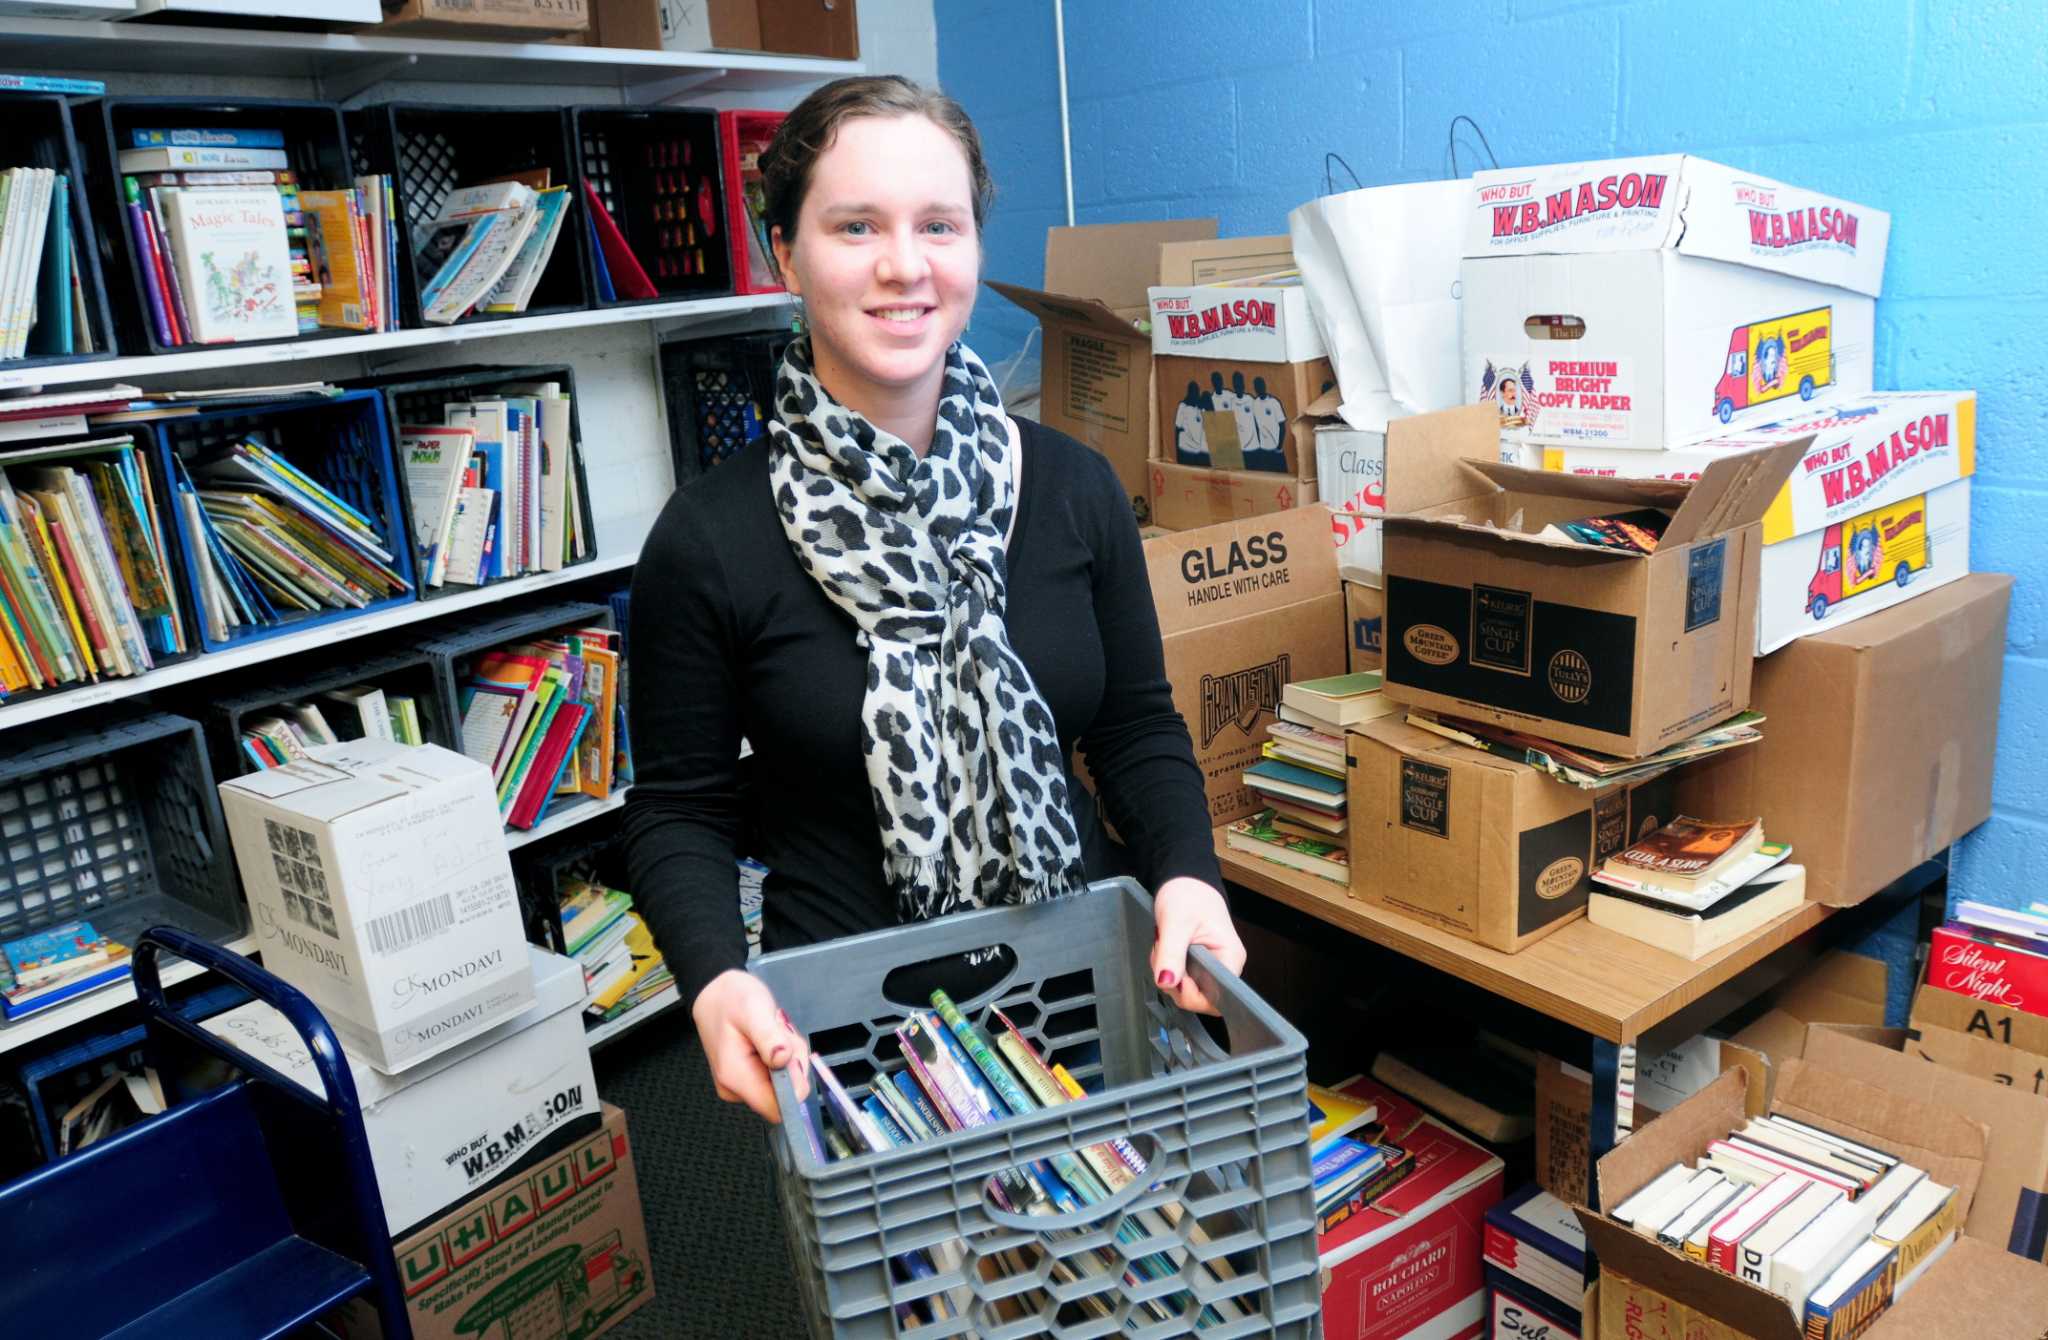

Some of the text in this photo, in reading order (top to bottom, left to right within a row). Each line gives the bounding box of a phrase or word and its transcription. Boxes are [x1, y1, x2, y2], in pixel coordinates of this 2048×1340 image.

[1481, 184, 1532, 203] WHO BUT
[1493, 173, 1667, 237] W.B.MASON
[190, 209, 276, 231] Magic Tales
[1621, 208, 1659, 219] PRINTING
[1748, 206, 1859, 249] W.B.MASON
[1168, 298, 1277, 340] W.B.MASON
[1549, 360, 1618, 377] PREMIUM
[1539, 391, 1632, 411] COPY PAPER
[1555, 377, 1612, 393] BRIGHT
[1340, 449, 1384, 477] Class
[1803, 442, 1852, 474] WHO BUT
[1820, 413, 1949, 508] W.B.MASON
[1181, 531, 1288, 584] GLASS
[1187, 567, 1290, 607] HANDLE WITH CARE
[1480, 621, 1521, 641] SINGLE
[1485, 637, 1516, 654] CUP
[1406, 790, 1445, 811] SINGLE
[1410, 806, 1440, 823] CUP
[280, 928, 349, 977] MONDAVI
[1943, 943, 2007, 974] Silent
[421, 948, 504, 996] MONDAVI
[1946, 970, 2024, 1006] Night
[417, 1002, 484, 1044] MONDAVI
[1967, 1008, 2013, 1045] A1
[462, 1085, 583, 1179] W.B.MSON
[445, 1134, 489, 1166] WHO BUT
[1373, 1246, 1447, 1297] BOUCHARD
